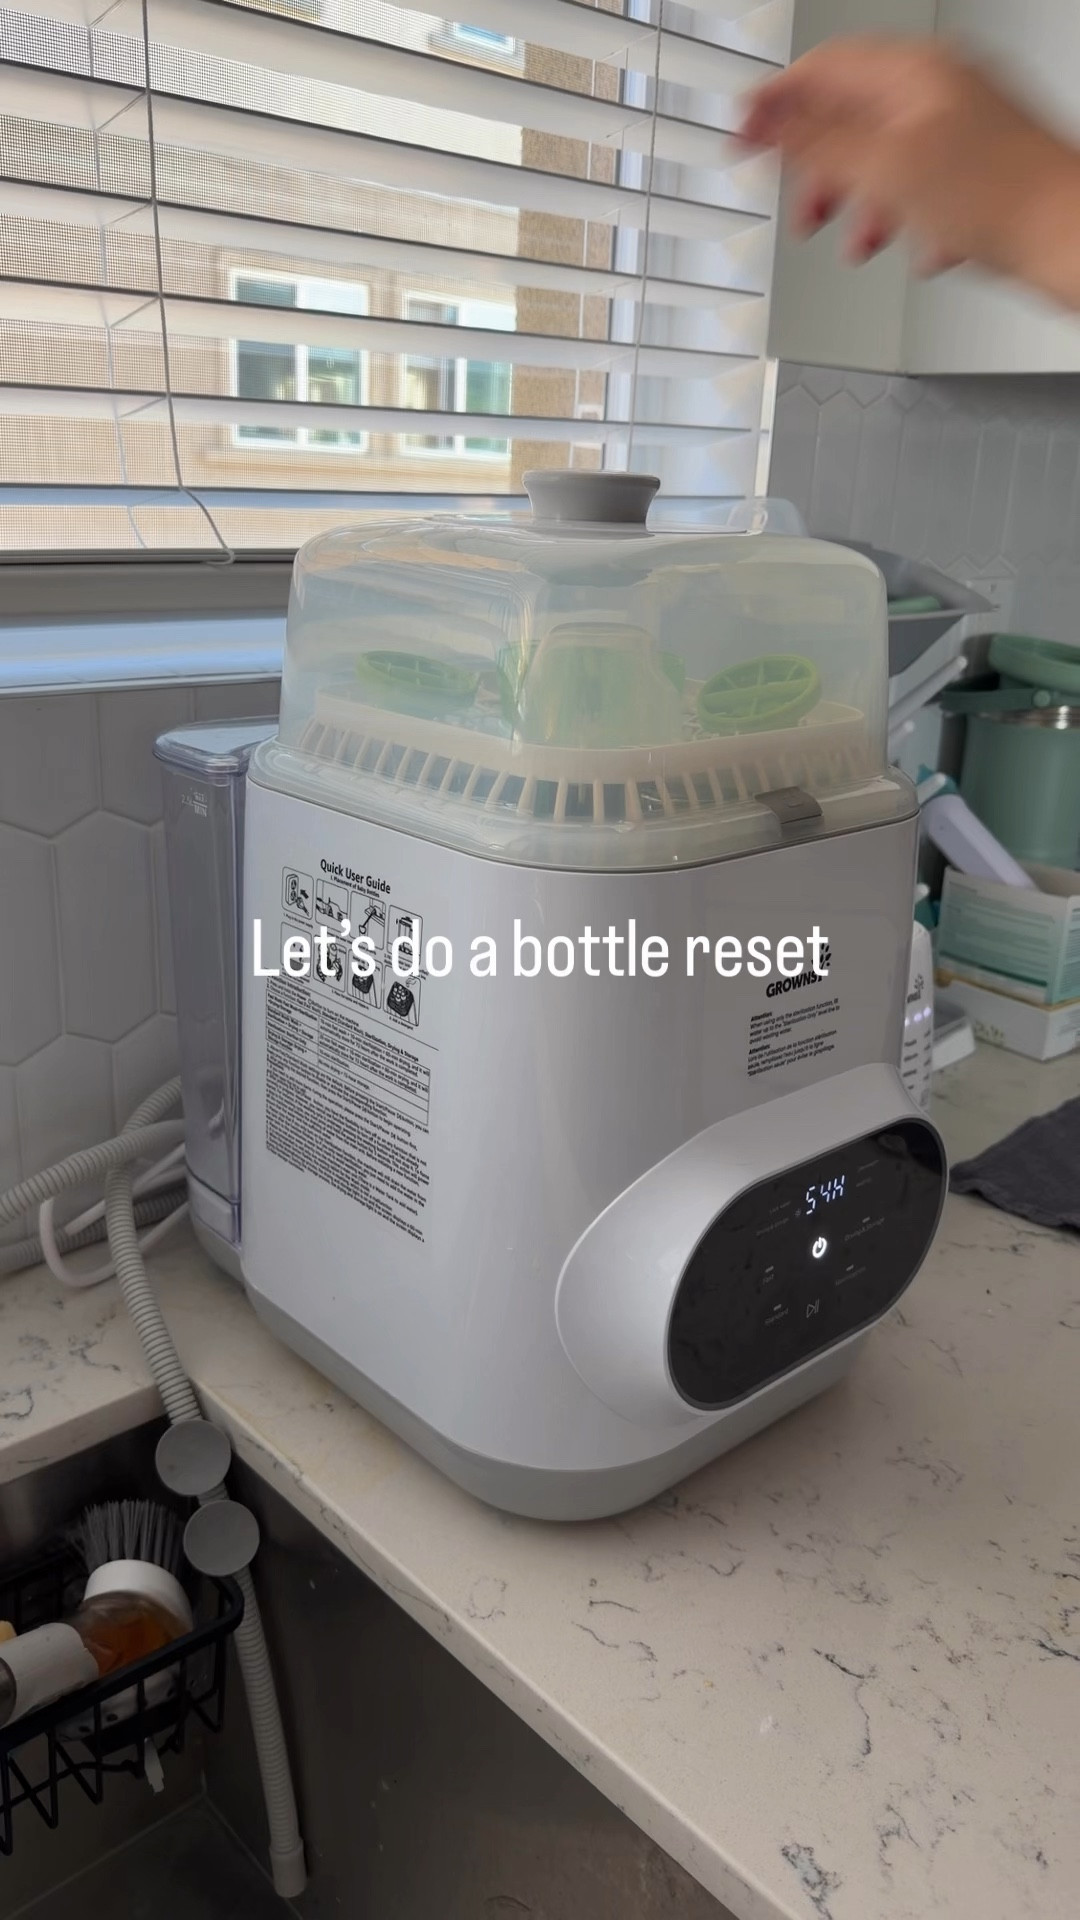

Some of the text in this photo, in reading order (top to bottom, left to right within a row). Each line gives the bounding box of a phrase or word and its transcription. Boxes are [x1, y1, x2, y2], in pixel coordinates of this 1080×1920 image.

[320, 858, 391, 894] Quick User Guide
[766, 970, 823, 998] GROWNS
